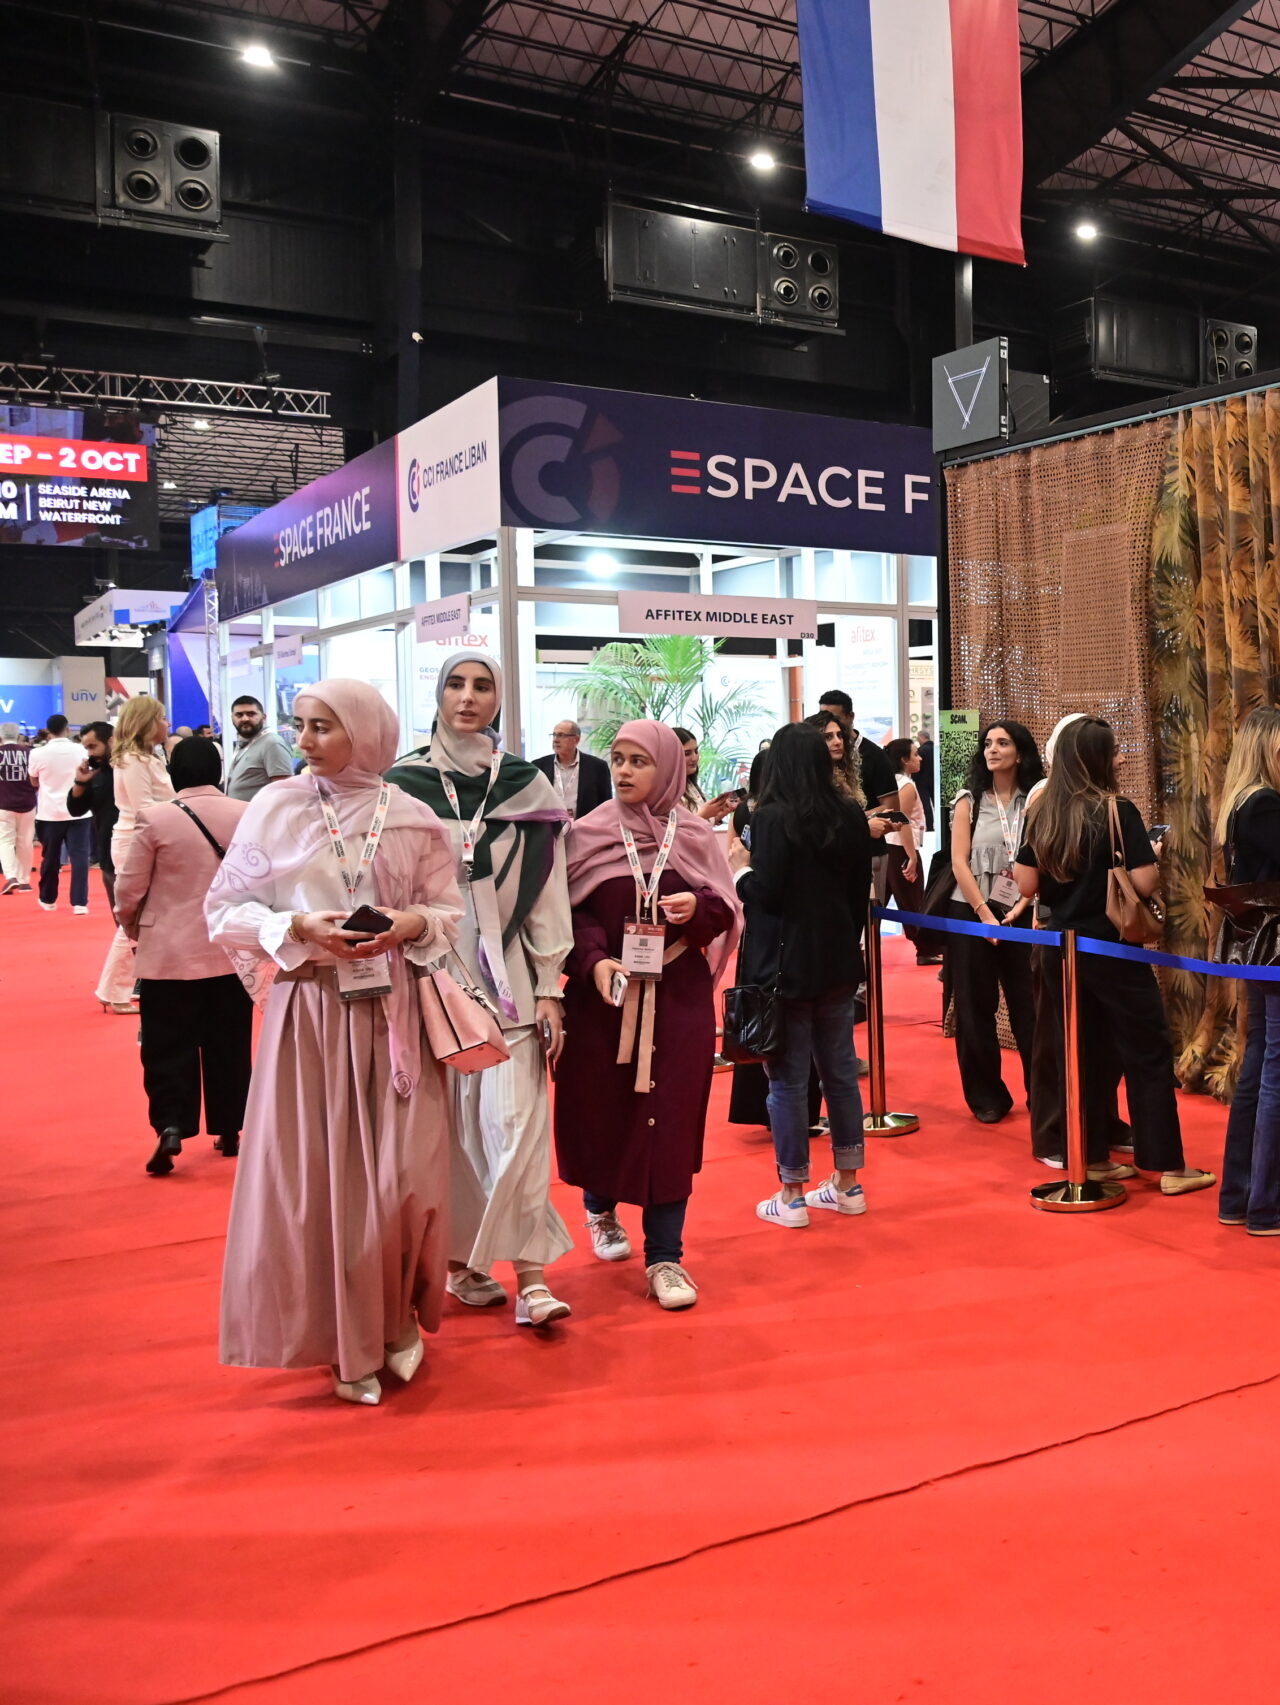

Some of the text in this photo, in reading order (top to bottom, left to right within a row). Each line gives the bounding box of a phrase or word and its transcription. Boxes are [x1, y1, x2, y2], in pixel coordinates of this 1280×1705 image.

[59, 447, 77, 468] 2
[81, 449, 141, 473] OCT
[422, 440, 487, 489] CCI FRANCE LIBAN
[670, 450, 886, 512] ESPACE
[38, 484, 131, 500] SEASIDE ARENA
[38, 497, 112, 511] BEIRUT NEW
[39, 511, 122, 525] WATERFRONT
[316, 486, 371, 551] FRANCE
[451, 608, 461, 622] EAST
[645, 608, 794, 625] AFFITEX MIDDLE EAST
[950, 714, 968, 724] SCAN.
